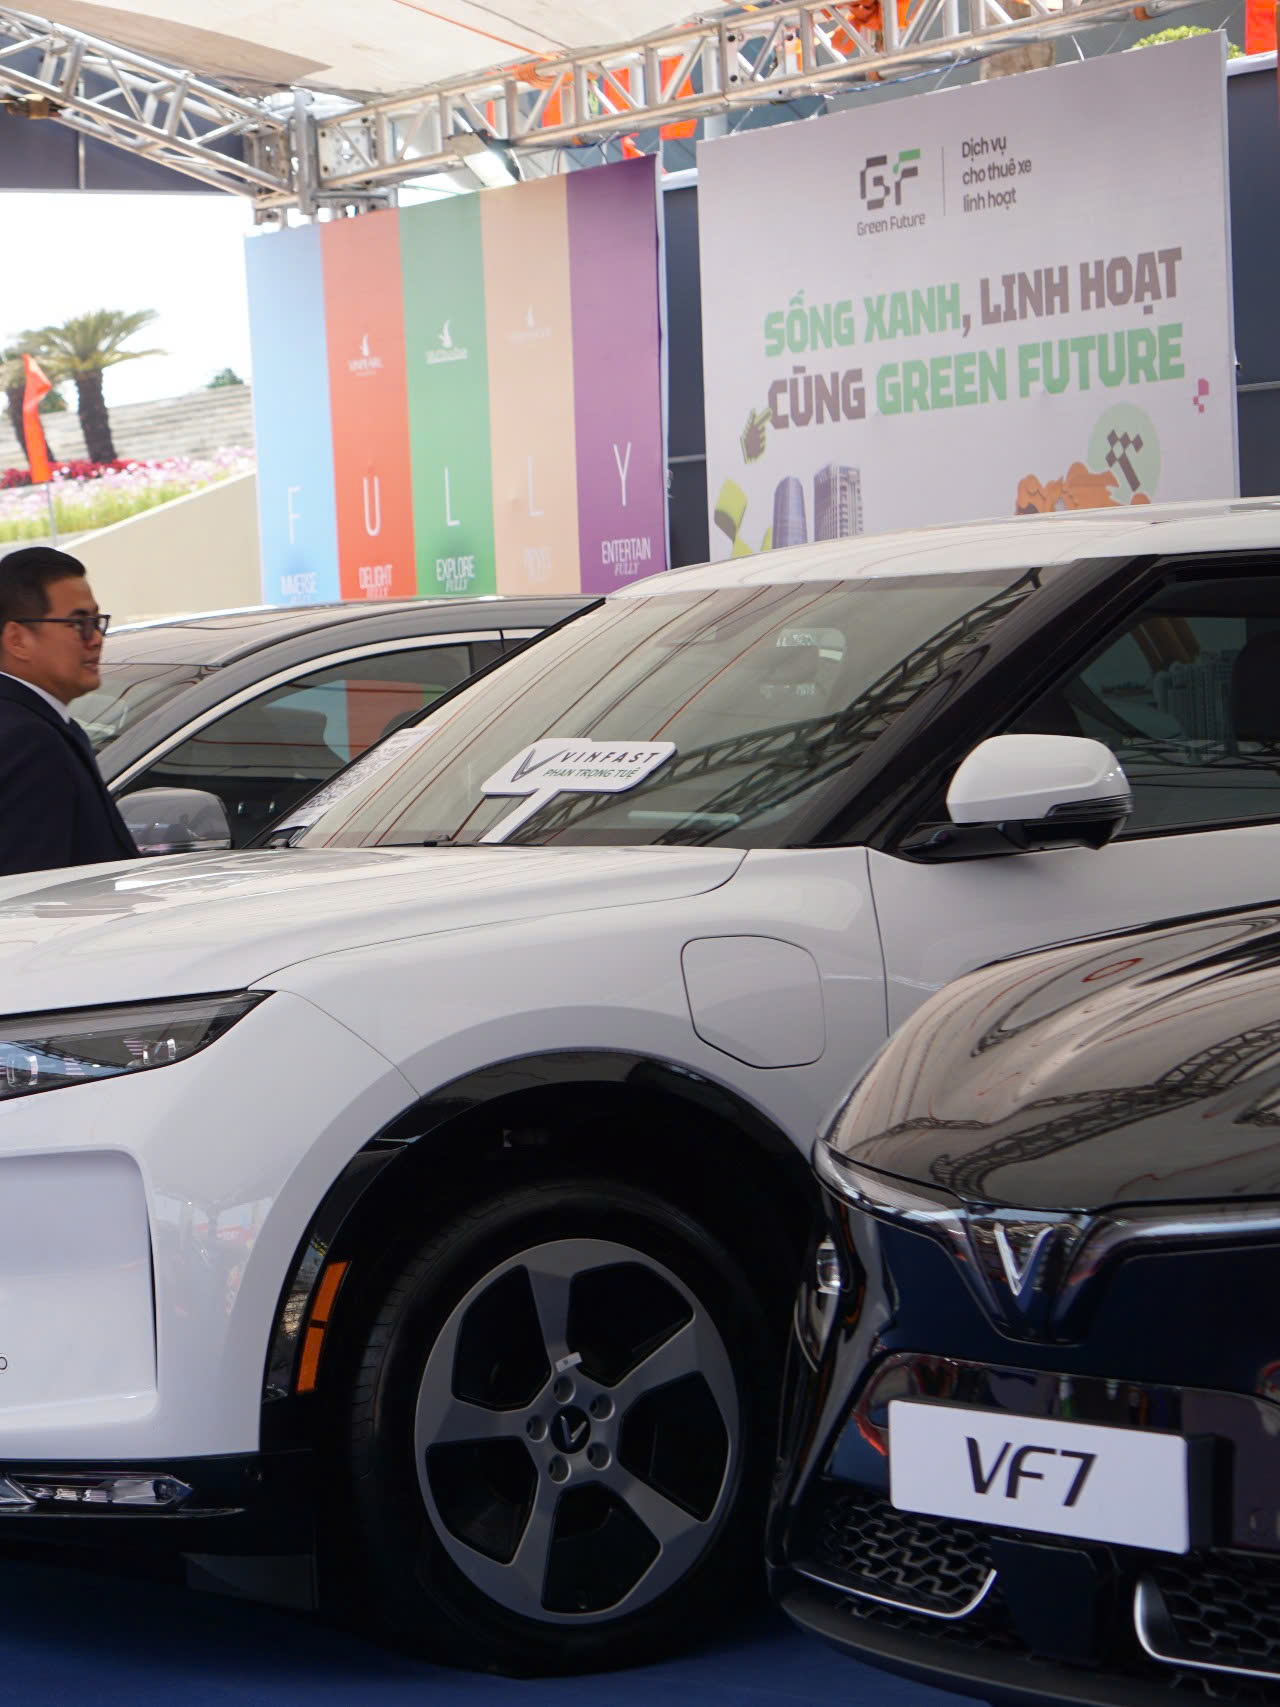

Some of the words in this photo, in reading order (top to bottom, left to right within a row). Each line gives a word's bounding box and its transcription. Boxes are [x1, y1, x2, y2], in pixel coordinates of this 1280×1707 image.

[961, 137, 989, 162] Dịch
[990, 136, 1007, 156] vụ
[962, 167, 986, 185] cho
[987, 158, 1016, 181] thuê
[1018, 159, 1032, 175] xe
[963, 192, 986, 212] linh
[987, 187, 1017, 210] hoạt
[856, 218, 888, 236] Green
[889, 212, 926, 230] Future
[763, 288, 856, 358] SỐNG
[863, 281, 971, 343] XANH,
[979, 265, 1070, 326] LINH
[1079, 246, 1183, 315] HOẠT
[875, 346, 1007, 416] GREEN
[1017, 322, 1185, 399] FUTURE
[601, 536, 651, 565] ENTERTAIN
[358, 564, 393, 589] DELIGHT
[435, 555, 475, 581] EXPLORE
[560, 751, 660, 764] VINFAST
[542, 768, 574, 777] PHAN
[574, 768, 616, 780] TRỌNG
[614, 766, 641, 780] TUỆ
[965, 1436, 1098, 1507] VF7
